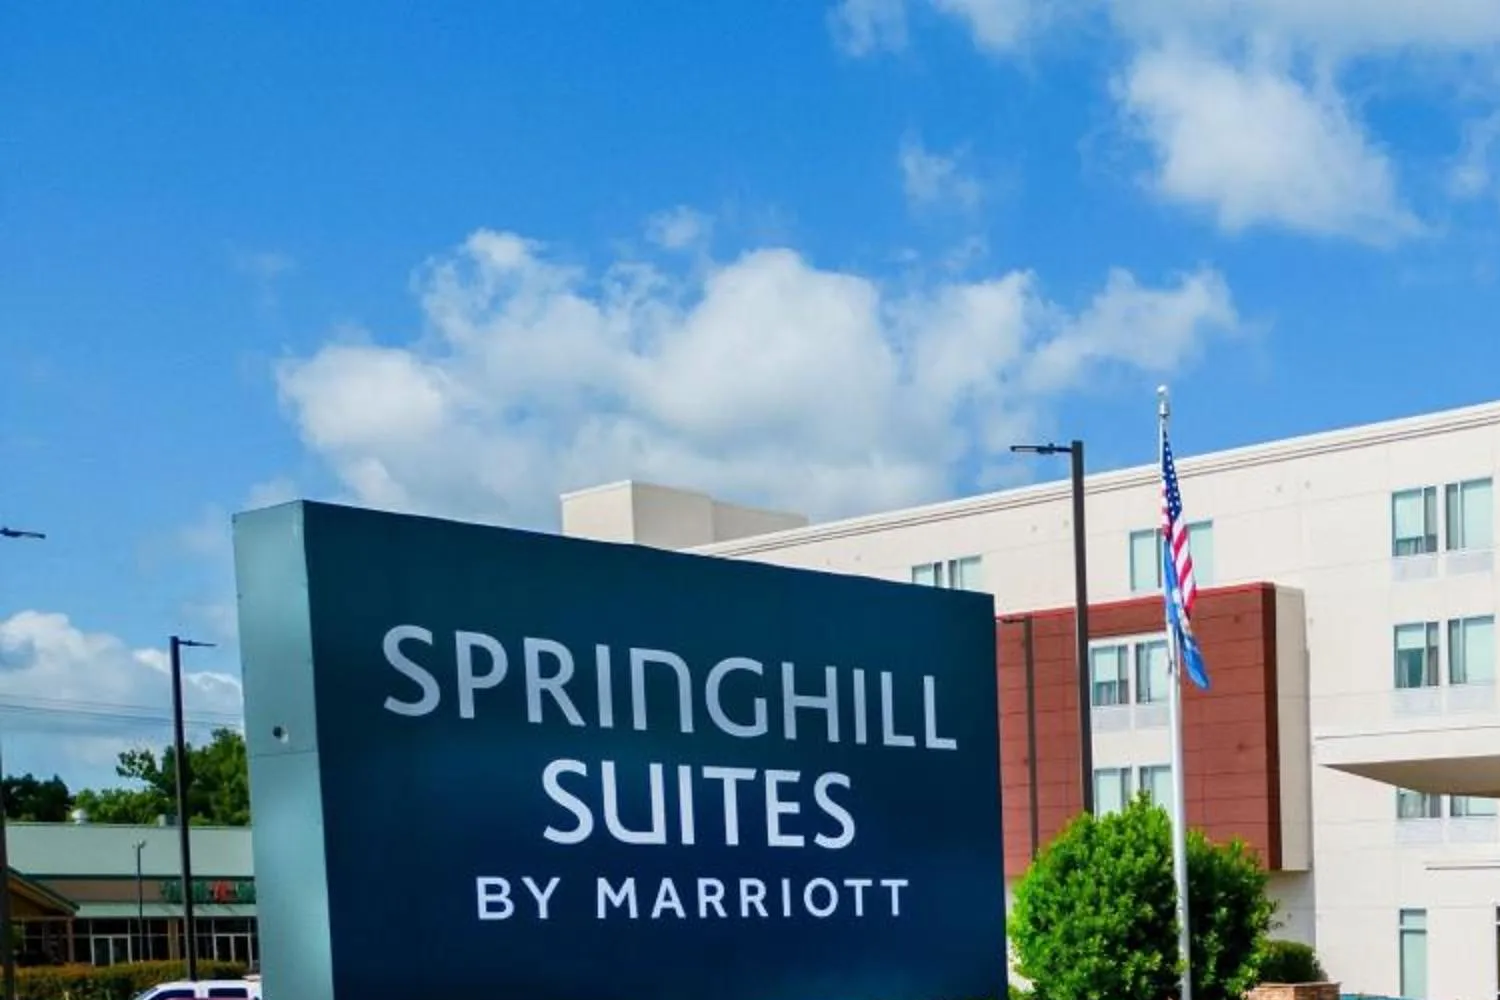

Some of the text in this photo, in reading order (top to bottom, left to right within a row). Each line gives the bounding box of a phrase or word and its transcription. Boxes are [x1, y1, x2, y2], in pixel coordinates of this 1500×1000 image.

[382, 624, 958, 750] SPRINGHILL
[541, 758, 857, 850] SUITES
[475, 875, 909, 921] BY MARRIOTT
